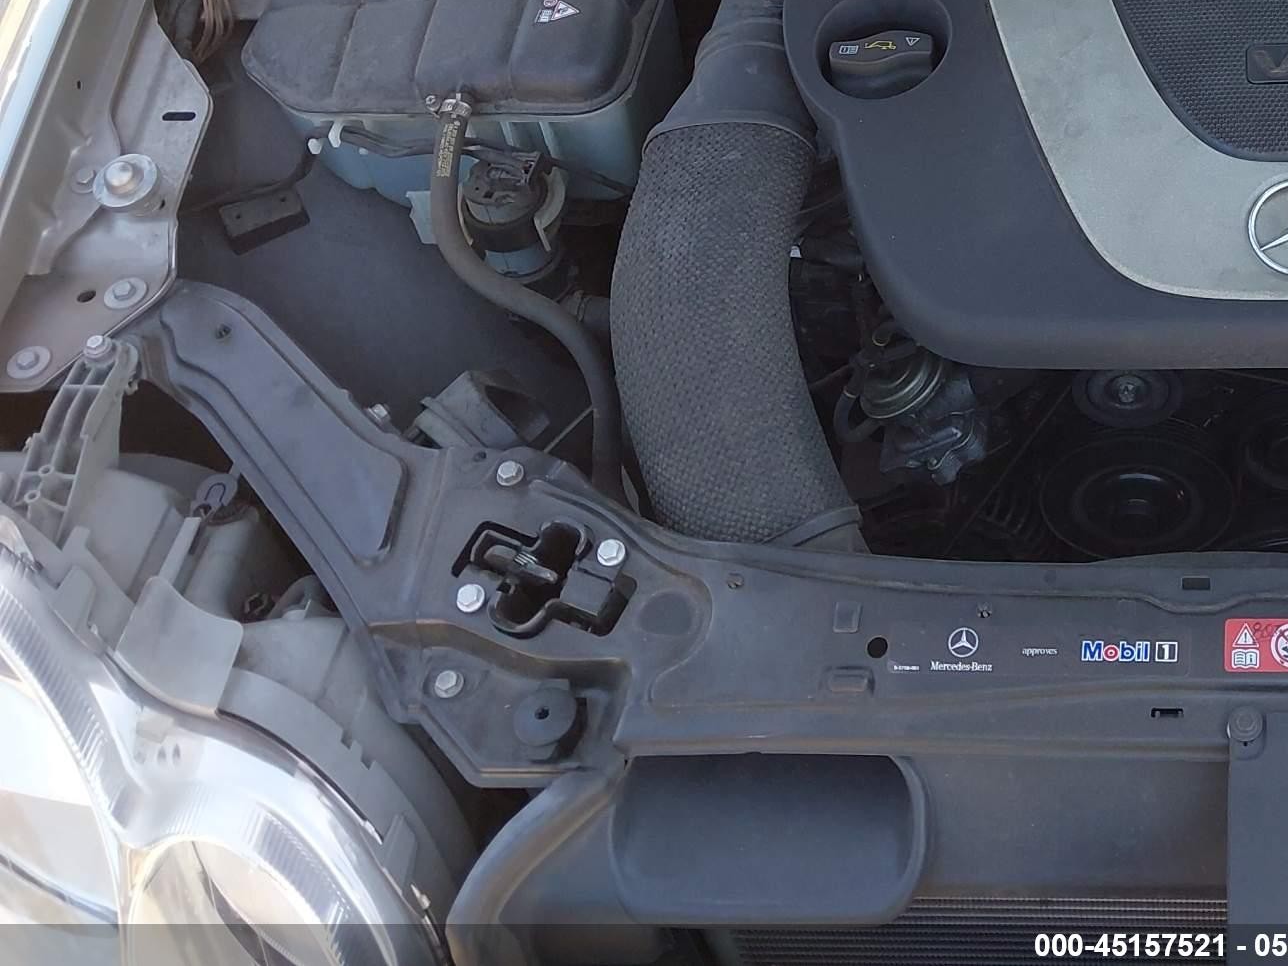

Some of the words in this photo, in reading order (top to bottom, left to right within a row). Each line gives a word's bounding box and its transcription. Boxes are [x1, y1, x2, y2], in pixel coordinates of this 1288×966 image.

[1021, 647, 1058, 657] approves
[1081, 640, 1151, 662] Mobil
[930, 661, 993, 672] Mercedes-Benz
